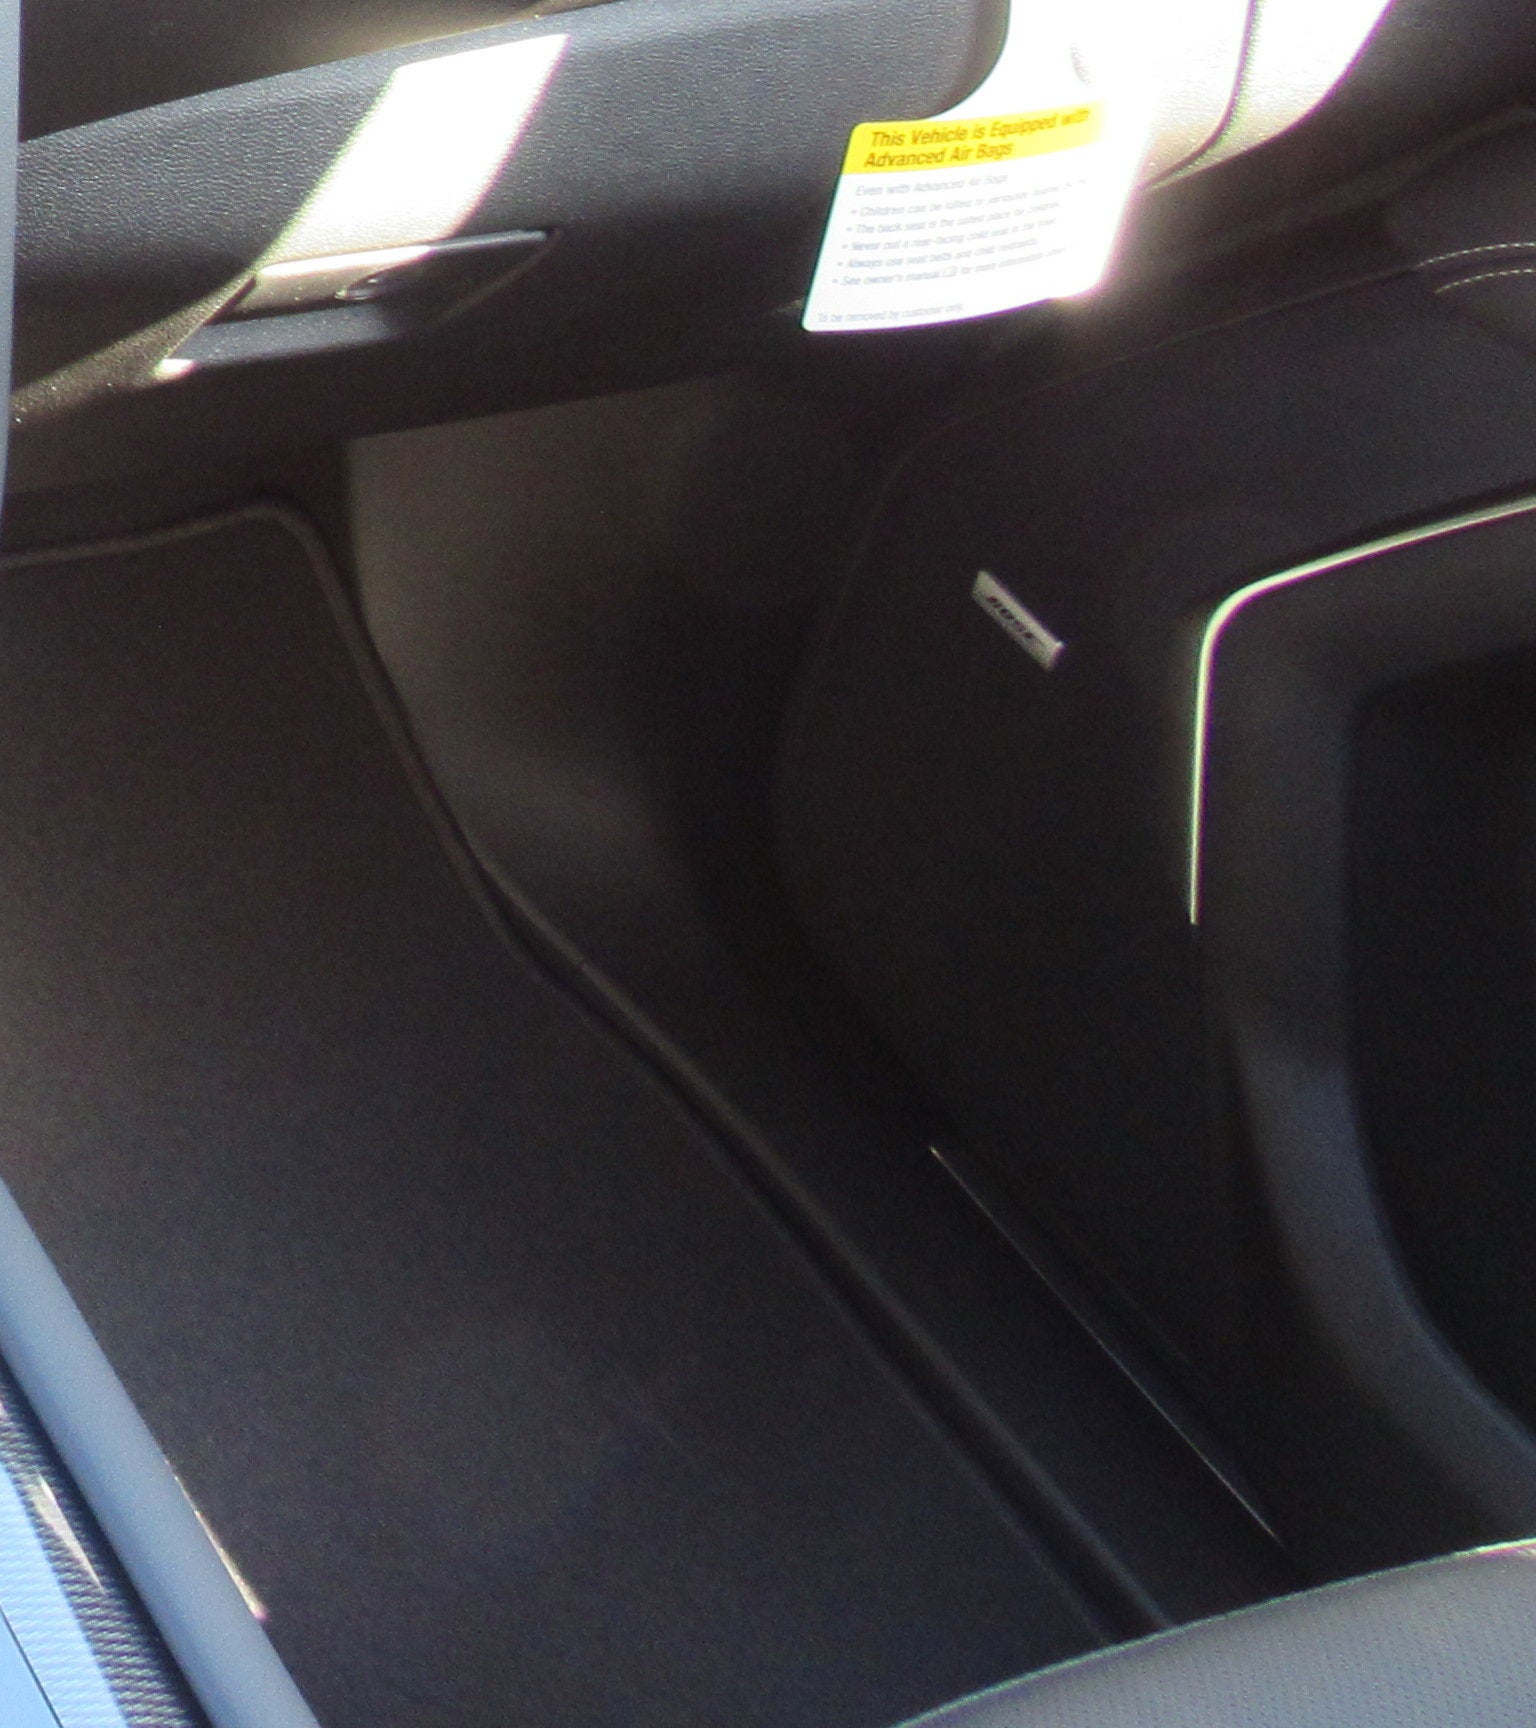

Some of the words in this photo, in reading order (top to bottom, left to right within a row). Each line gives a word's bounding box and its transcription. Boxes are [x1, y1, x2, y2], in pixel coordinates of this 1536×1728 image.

[871, 130, 905, 148] This
[910, 125, 969, 146] Vehicle
[972, 124, 985, 139] is
[990, 114, 1058, 139] Equipped
[1060, 107, 1091, 127] with
[863, 146, 945, 168] Advanced
[948, 144, 974, 163] Air
[976, 141, 1013, 161] Bags
